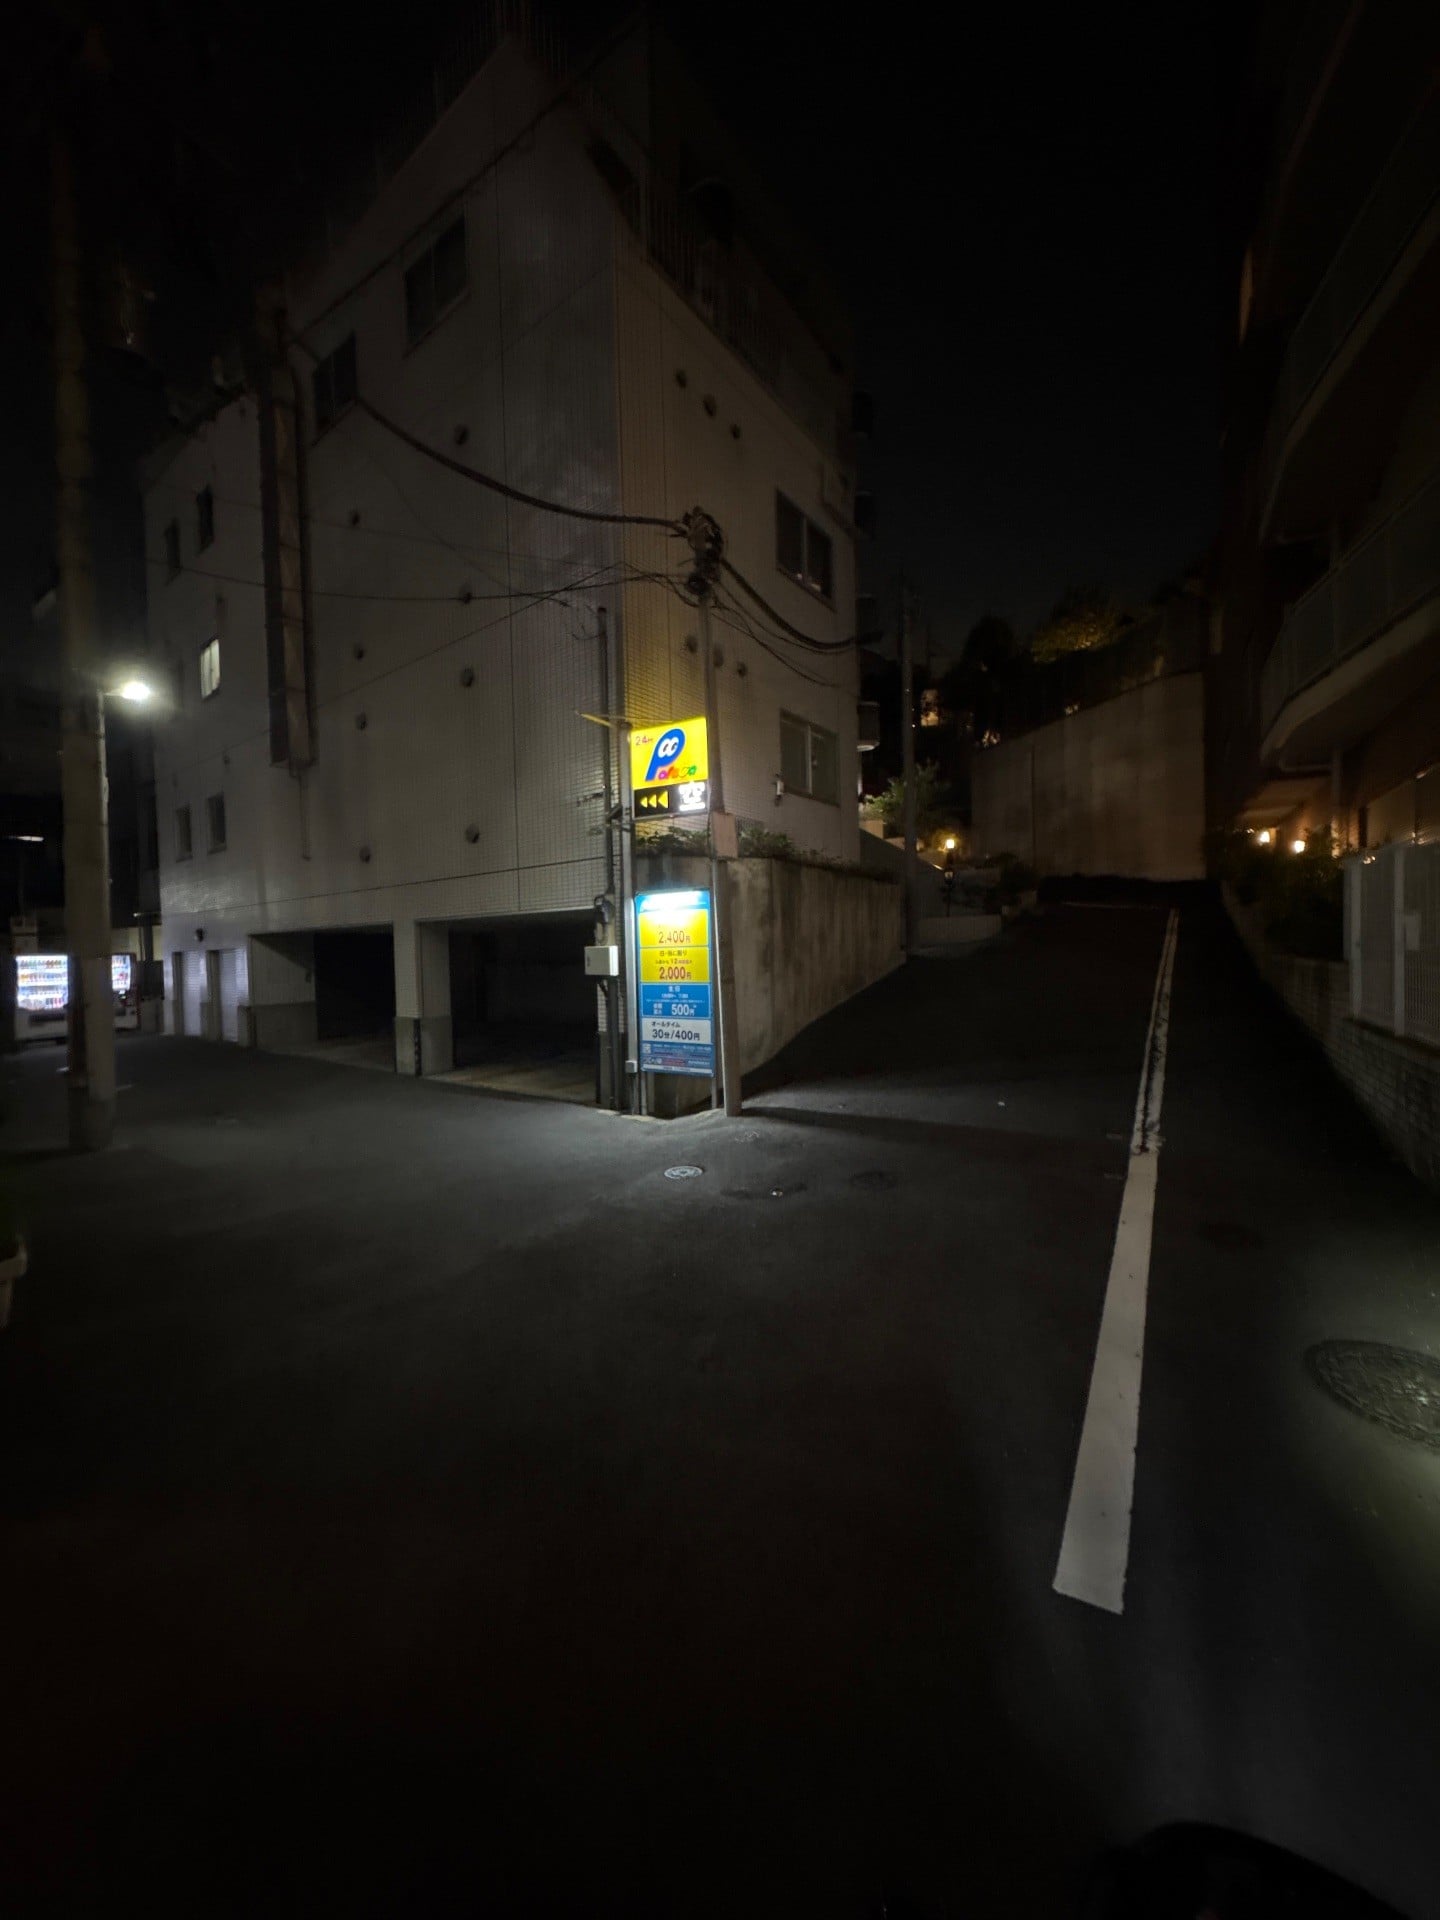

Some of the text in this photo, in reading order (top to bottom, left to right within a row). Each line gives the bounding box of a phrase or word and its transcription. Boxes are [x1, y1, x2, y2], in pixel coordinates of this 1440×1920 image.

[658, 930, 691, 944] 2,400円
[659, 966, 692, 980] 2,000円
[671, 1004, 695, 1016] 500円
[652, 1029, 700, 1041] 30分/400円
